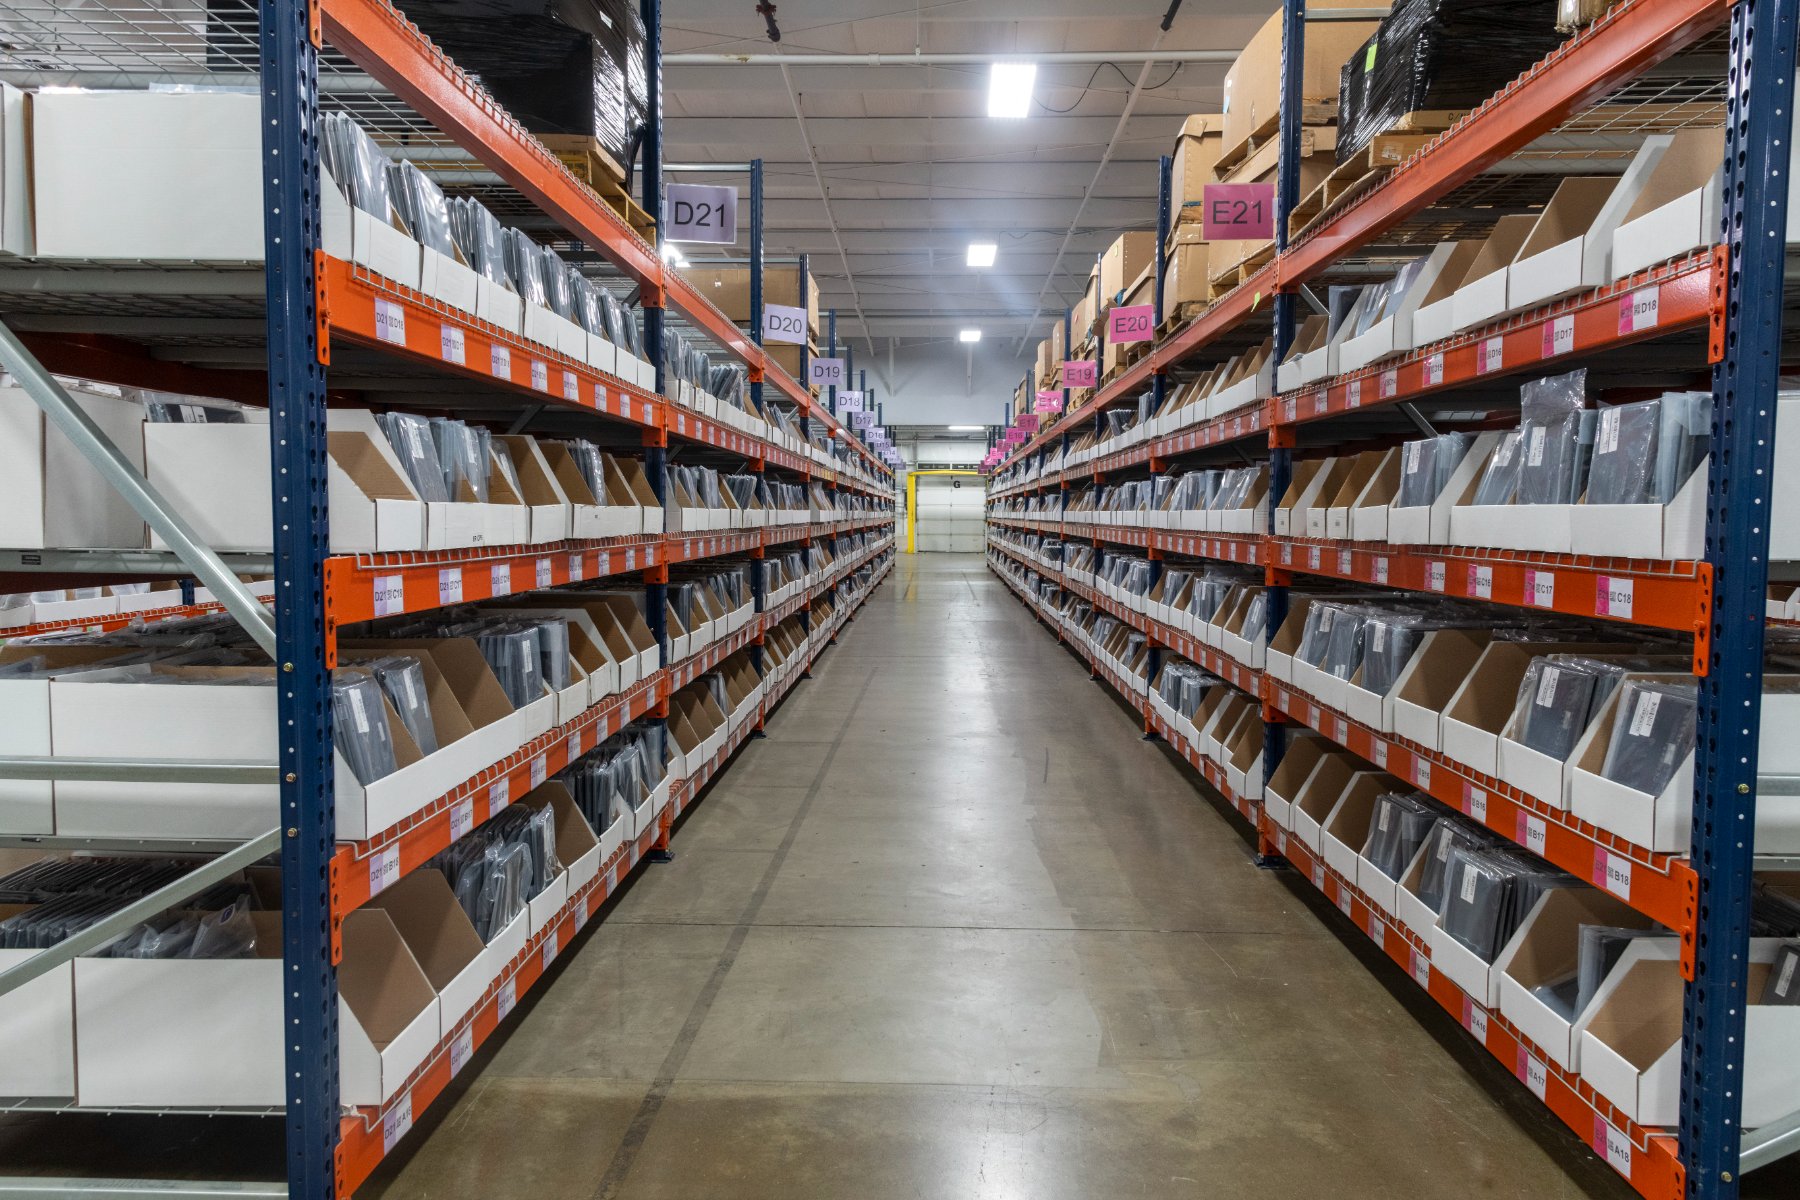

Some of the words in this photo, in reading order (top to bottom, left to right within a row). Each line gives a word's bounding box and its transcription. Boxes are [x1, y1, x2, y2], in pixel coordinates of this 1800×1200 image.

[674, 201, 725, 228] D21
[1213, 200, 1262, 225] E21
[1641, 299, 1657, 314] D18
[376, 312, 388, 326] D21
[769, 314, 803, 334] D20
[1115, 315, 1148, 334] E20
[1560, 327, 1573, 339] D17
[442, 336, 452, 348] D21
[814, 365, 840, 378] D19
[1066, 367, 1092, 381] E19
[839, 396, 861, 407] D18
[855, 416, 872, 425] D17
[1019, 418, 1037, 428] E17
[868, 431, 885, 439] D16
[953, 480, 961, 489] G
[440, 582, 449, 592] D21
[454, 580, 462, 590] C17
[1540, 584, 1553, 594] C17
[375, 590, 387, 602] D21
[392, 588, 403, 600] C18
[1616, 592, 1632, 604] C18
[1476, 799, 1486, 812] B16
[451, 818, 460, 830] D21
[1532, 830, 1545, 842] B17
[370, 868, 383, 882] D21
[388, 856, 399, 872] B18
[1614, 870, 1629, 886] B18
[1420, 966, 1428, 979] A15
[1476, 1019, 1486, 1033] A16
[452, 1052, 460, 1067] D21
[1533, 1072, 1545, 1087] A17
[384, 1122, 396, 1140] D21
[1614, 1144, 1630, 1164] A18
